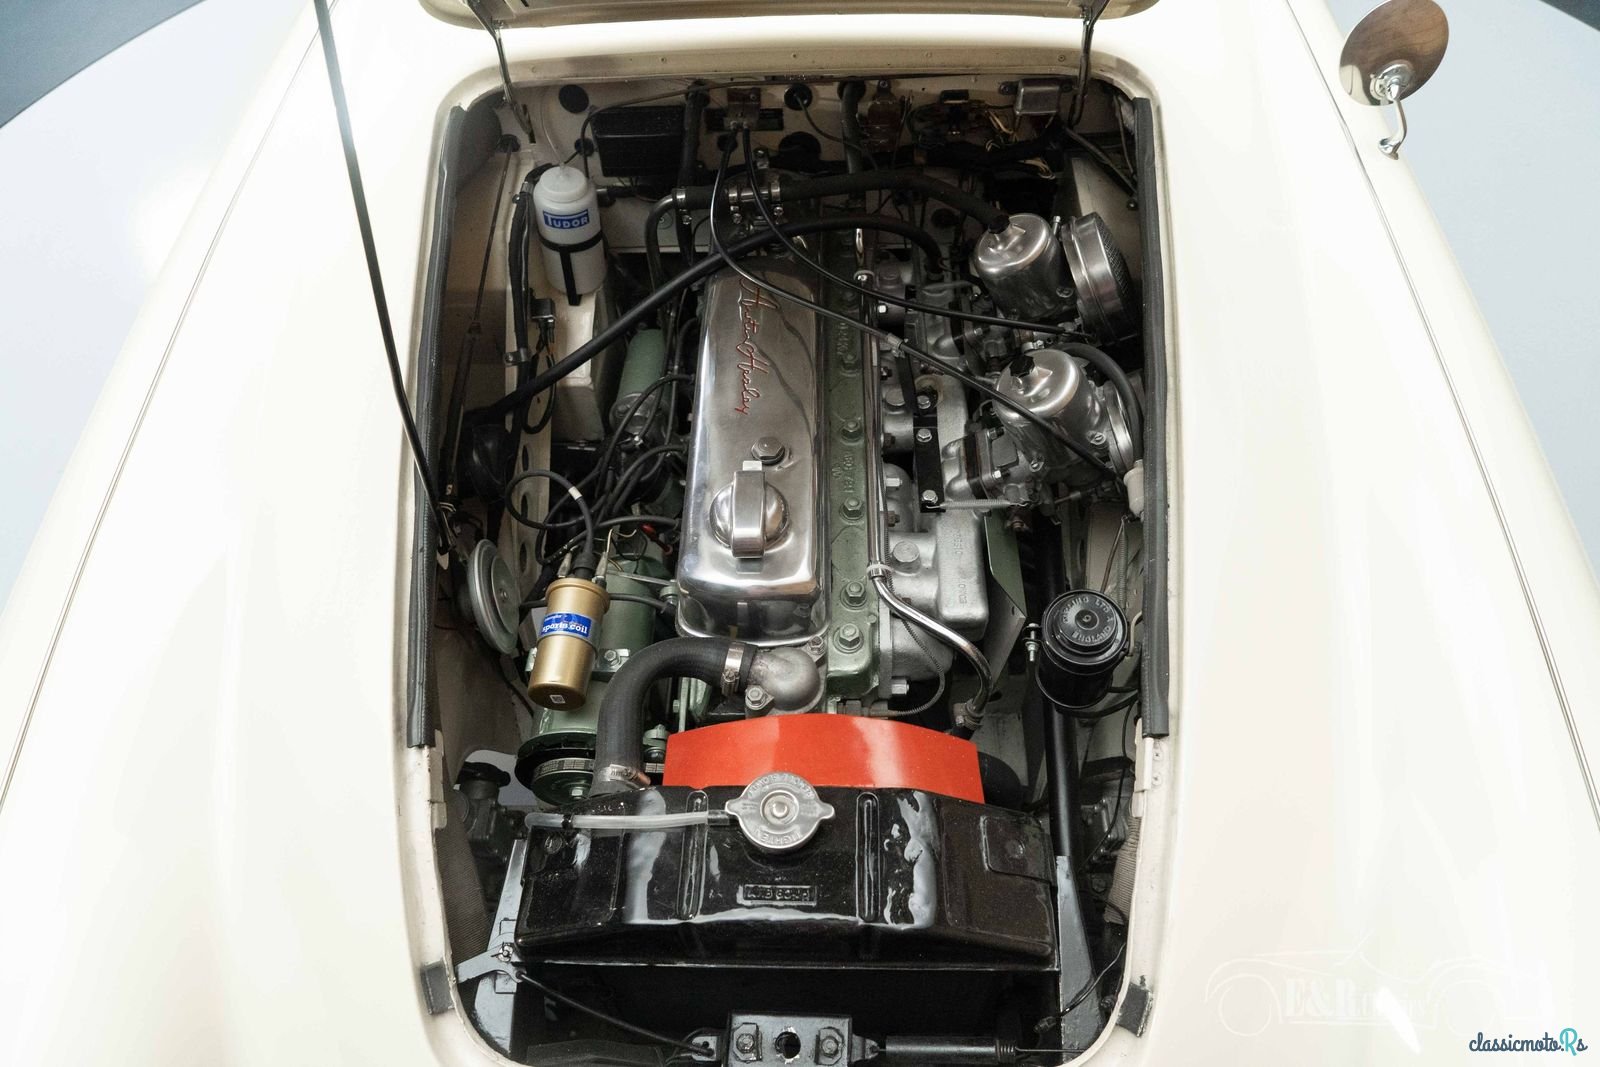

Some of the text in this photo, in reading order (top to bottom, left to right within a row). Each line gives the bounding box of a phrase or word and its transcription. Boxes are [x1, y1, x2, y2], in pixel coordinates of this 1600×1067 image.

[542, 622, 588, 634] sports coil
[1071, 626, 1112, 643] ENGLAND
